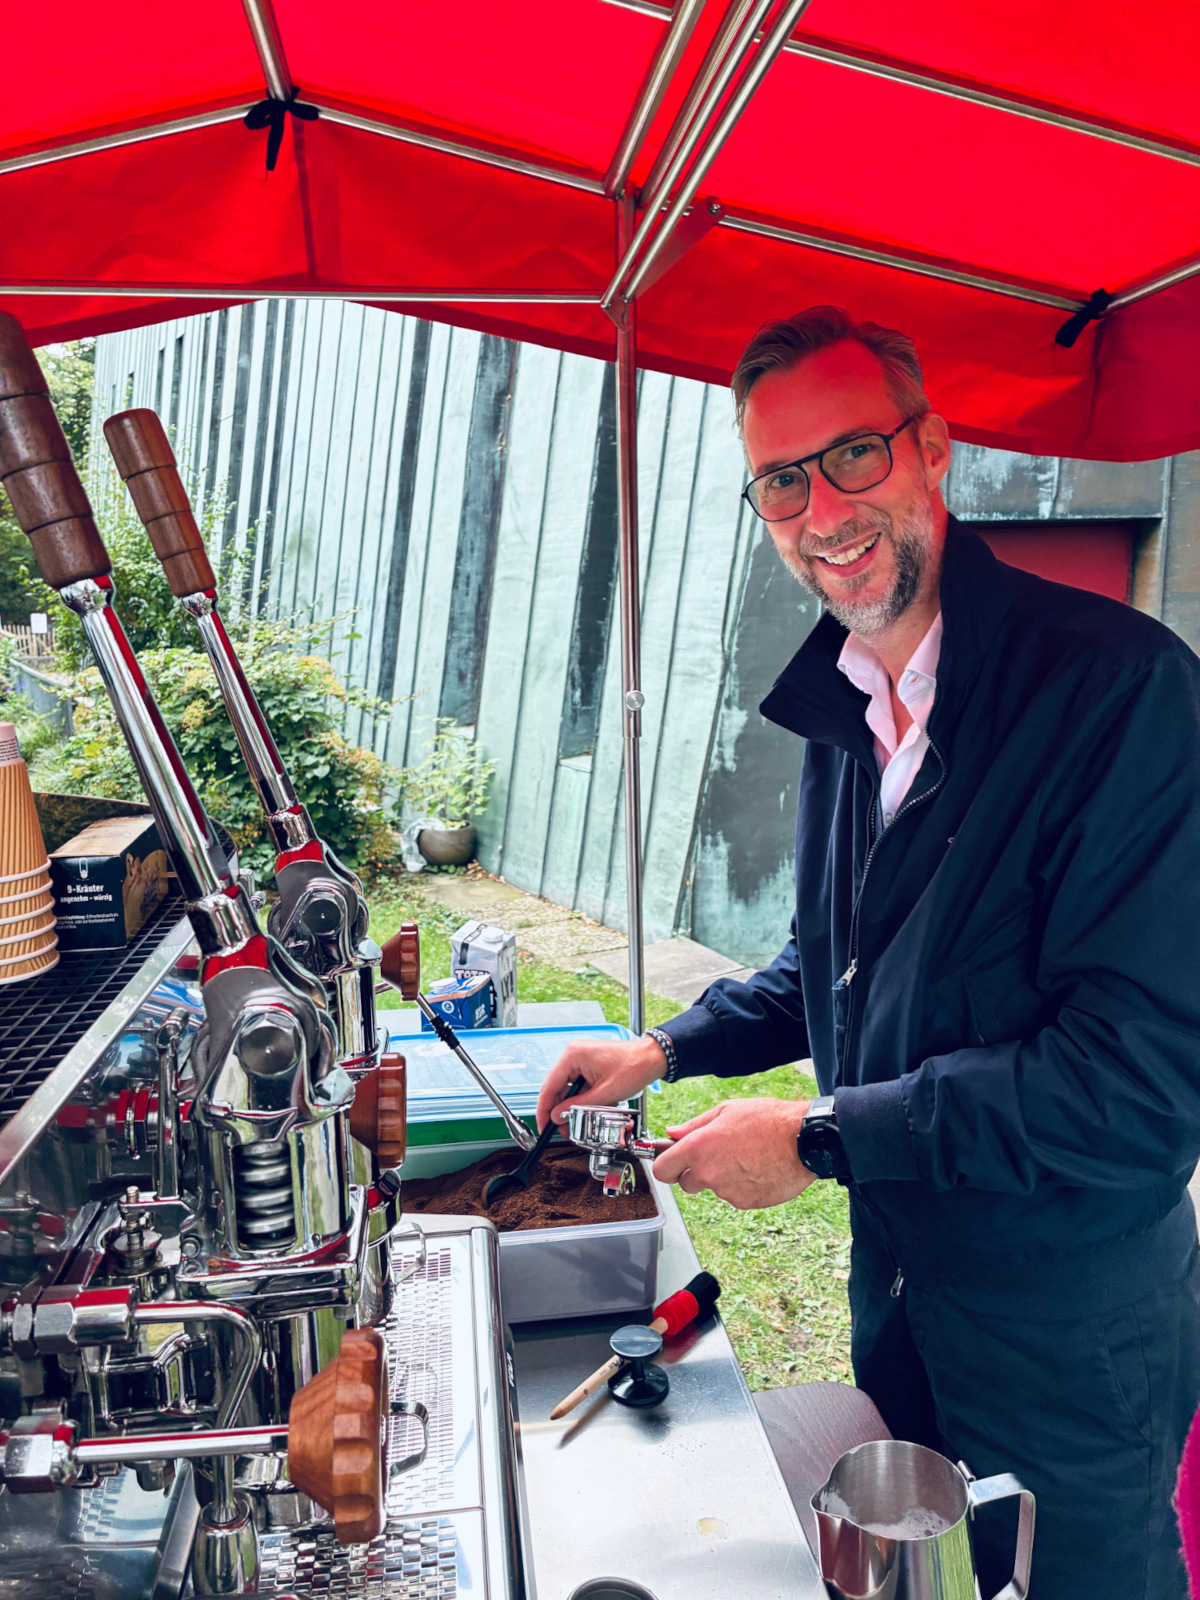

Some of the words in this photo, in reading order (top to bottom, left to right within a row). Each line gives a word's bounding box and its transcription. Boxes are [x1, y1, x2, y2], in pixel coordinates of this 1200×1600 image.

[67, 884, 104, 894] 9-Kräuter
[60, 895, 88, 904] angenehm
[93, 893, 112, 901] würzig
[455, 969, 490, 980] TOT
